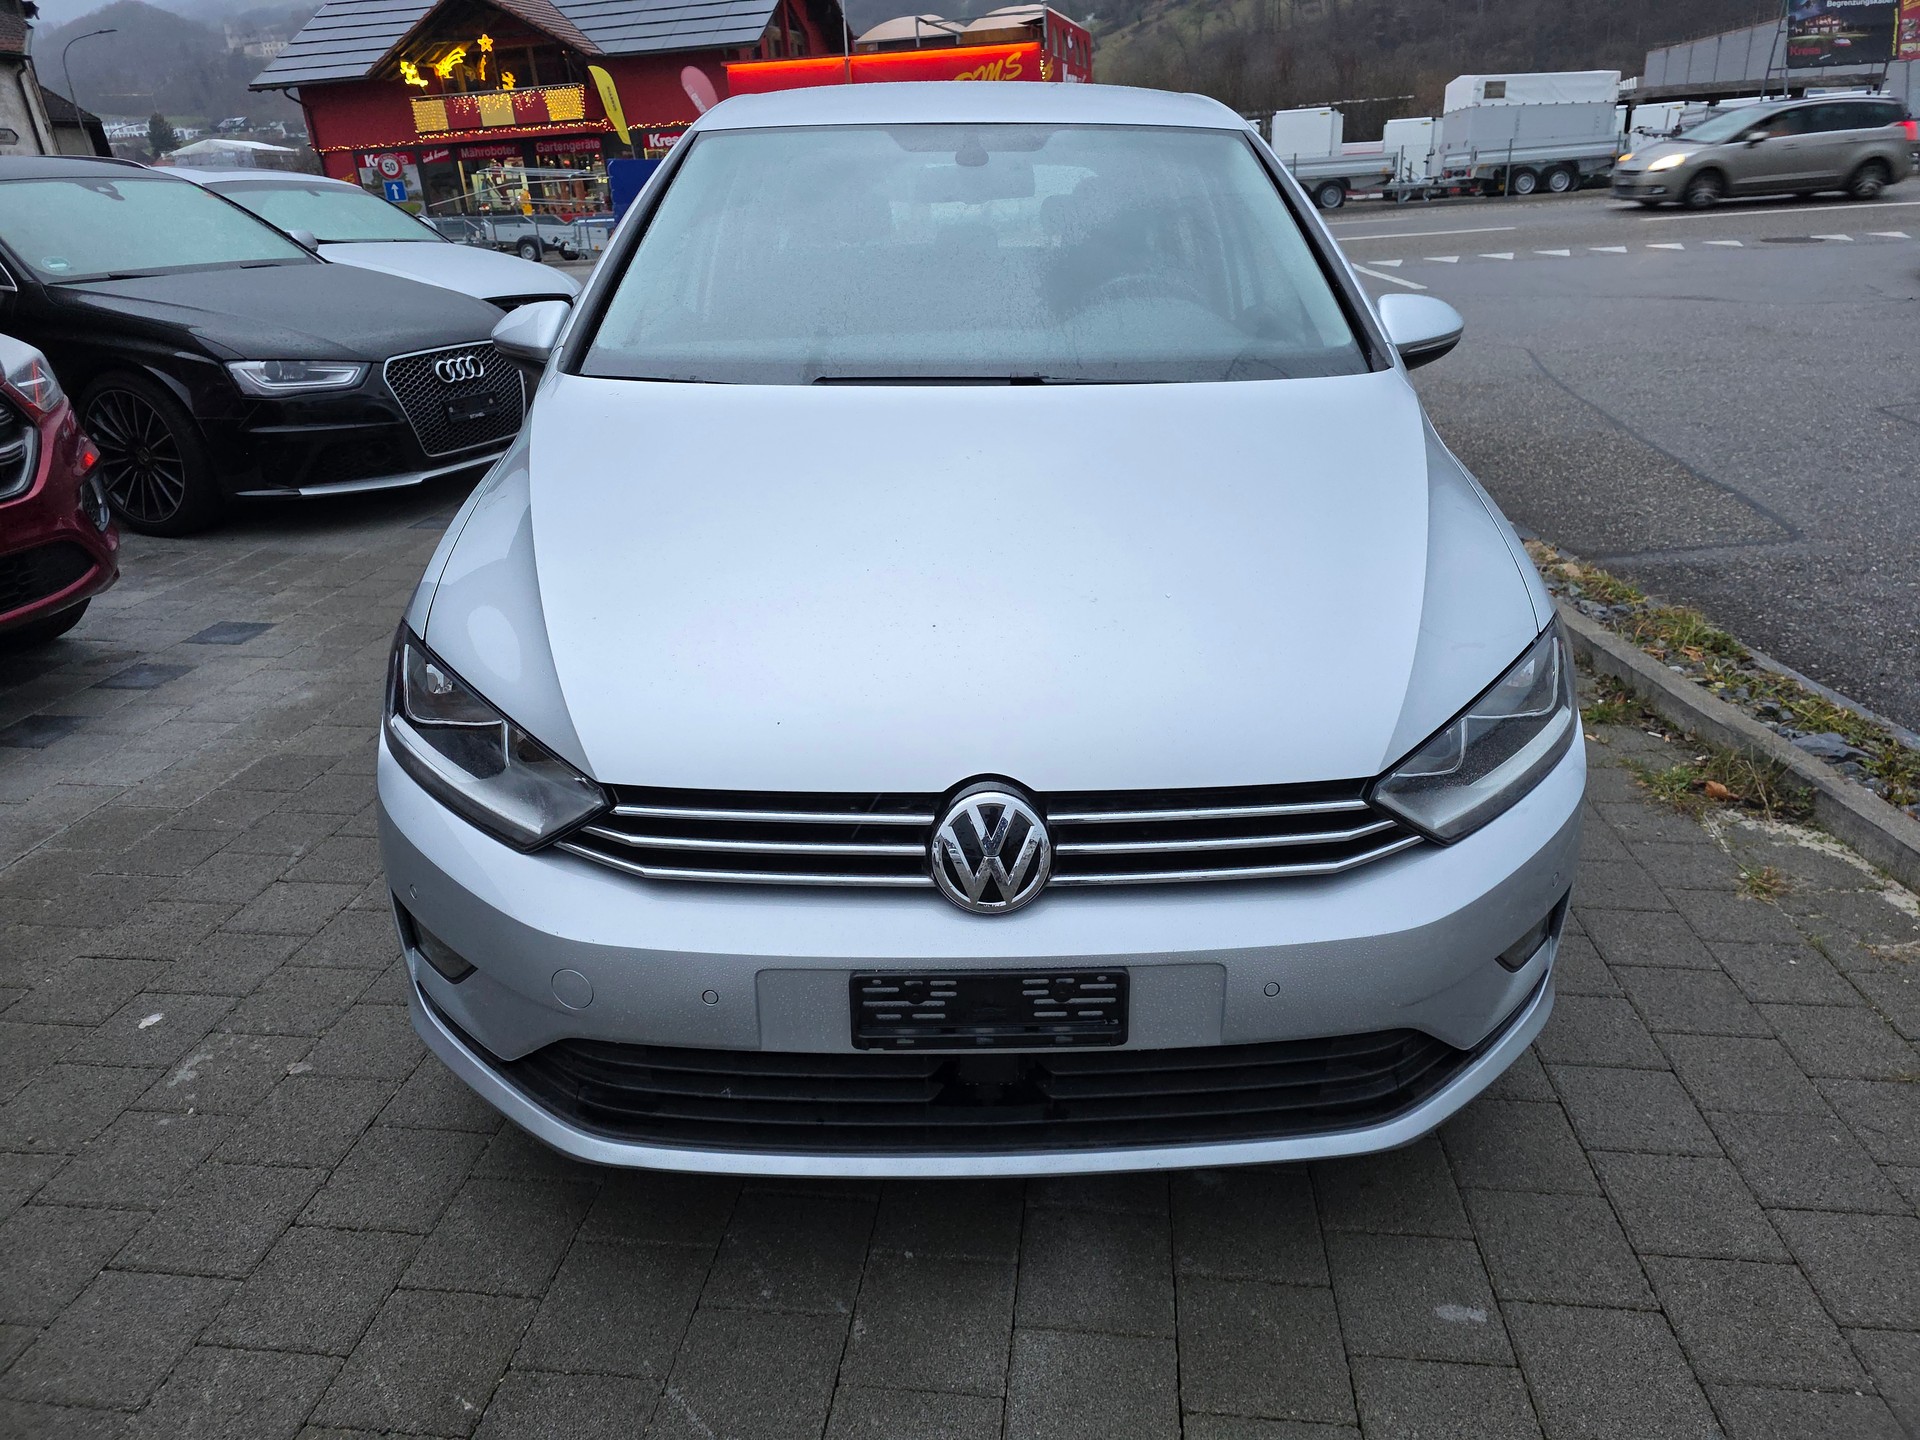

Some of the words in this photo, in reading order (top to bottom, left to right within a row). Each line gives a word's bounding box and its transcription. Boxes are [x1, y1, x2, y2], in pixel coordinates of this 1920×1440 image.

[460, 146, 517, 159] Mähroboter
[535, 138, 601, 153] Gartengeräte
[384, 162, 396, 172] 50
[932, 793, 1050, 912] VW
